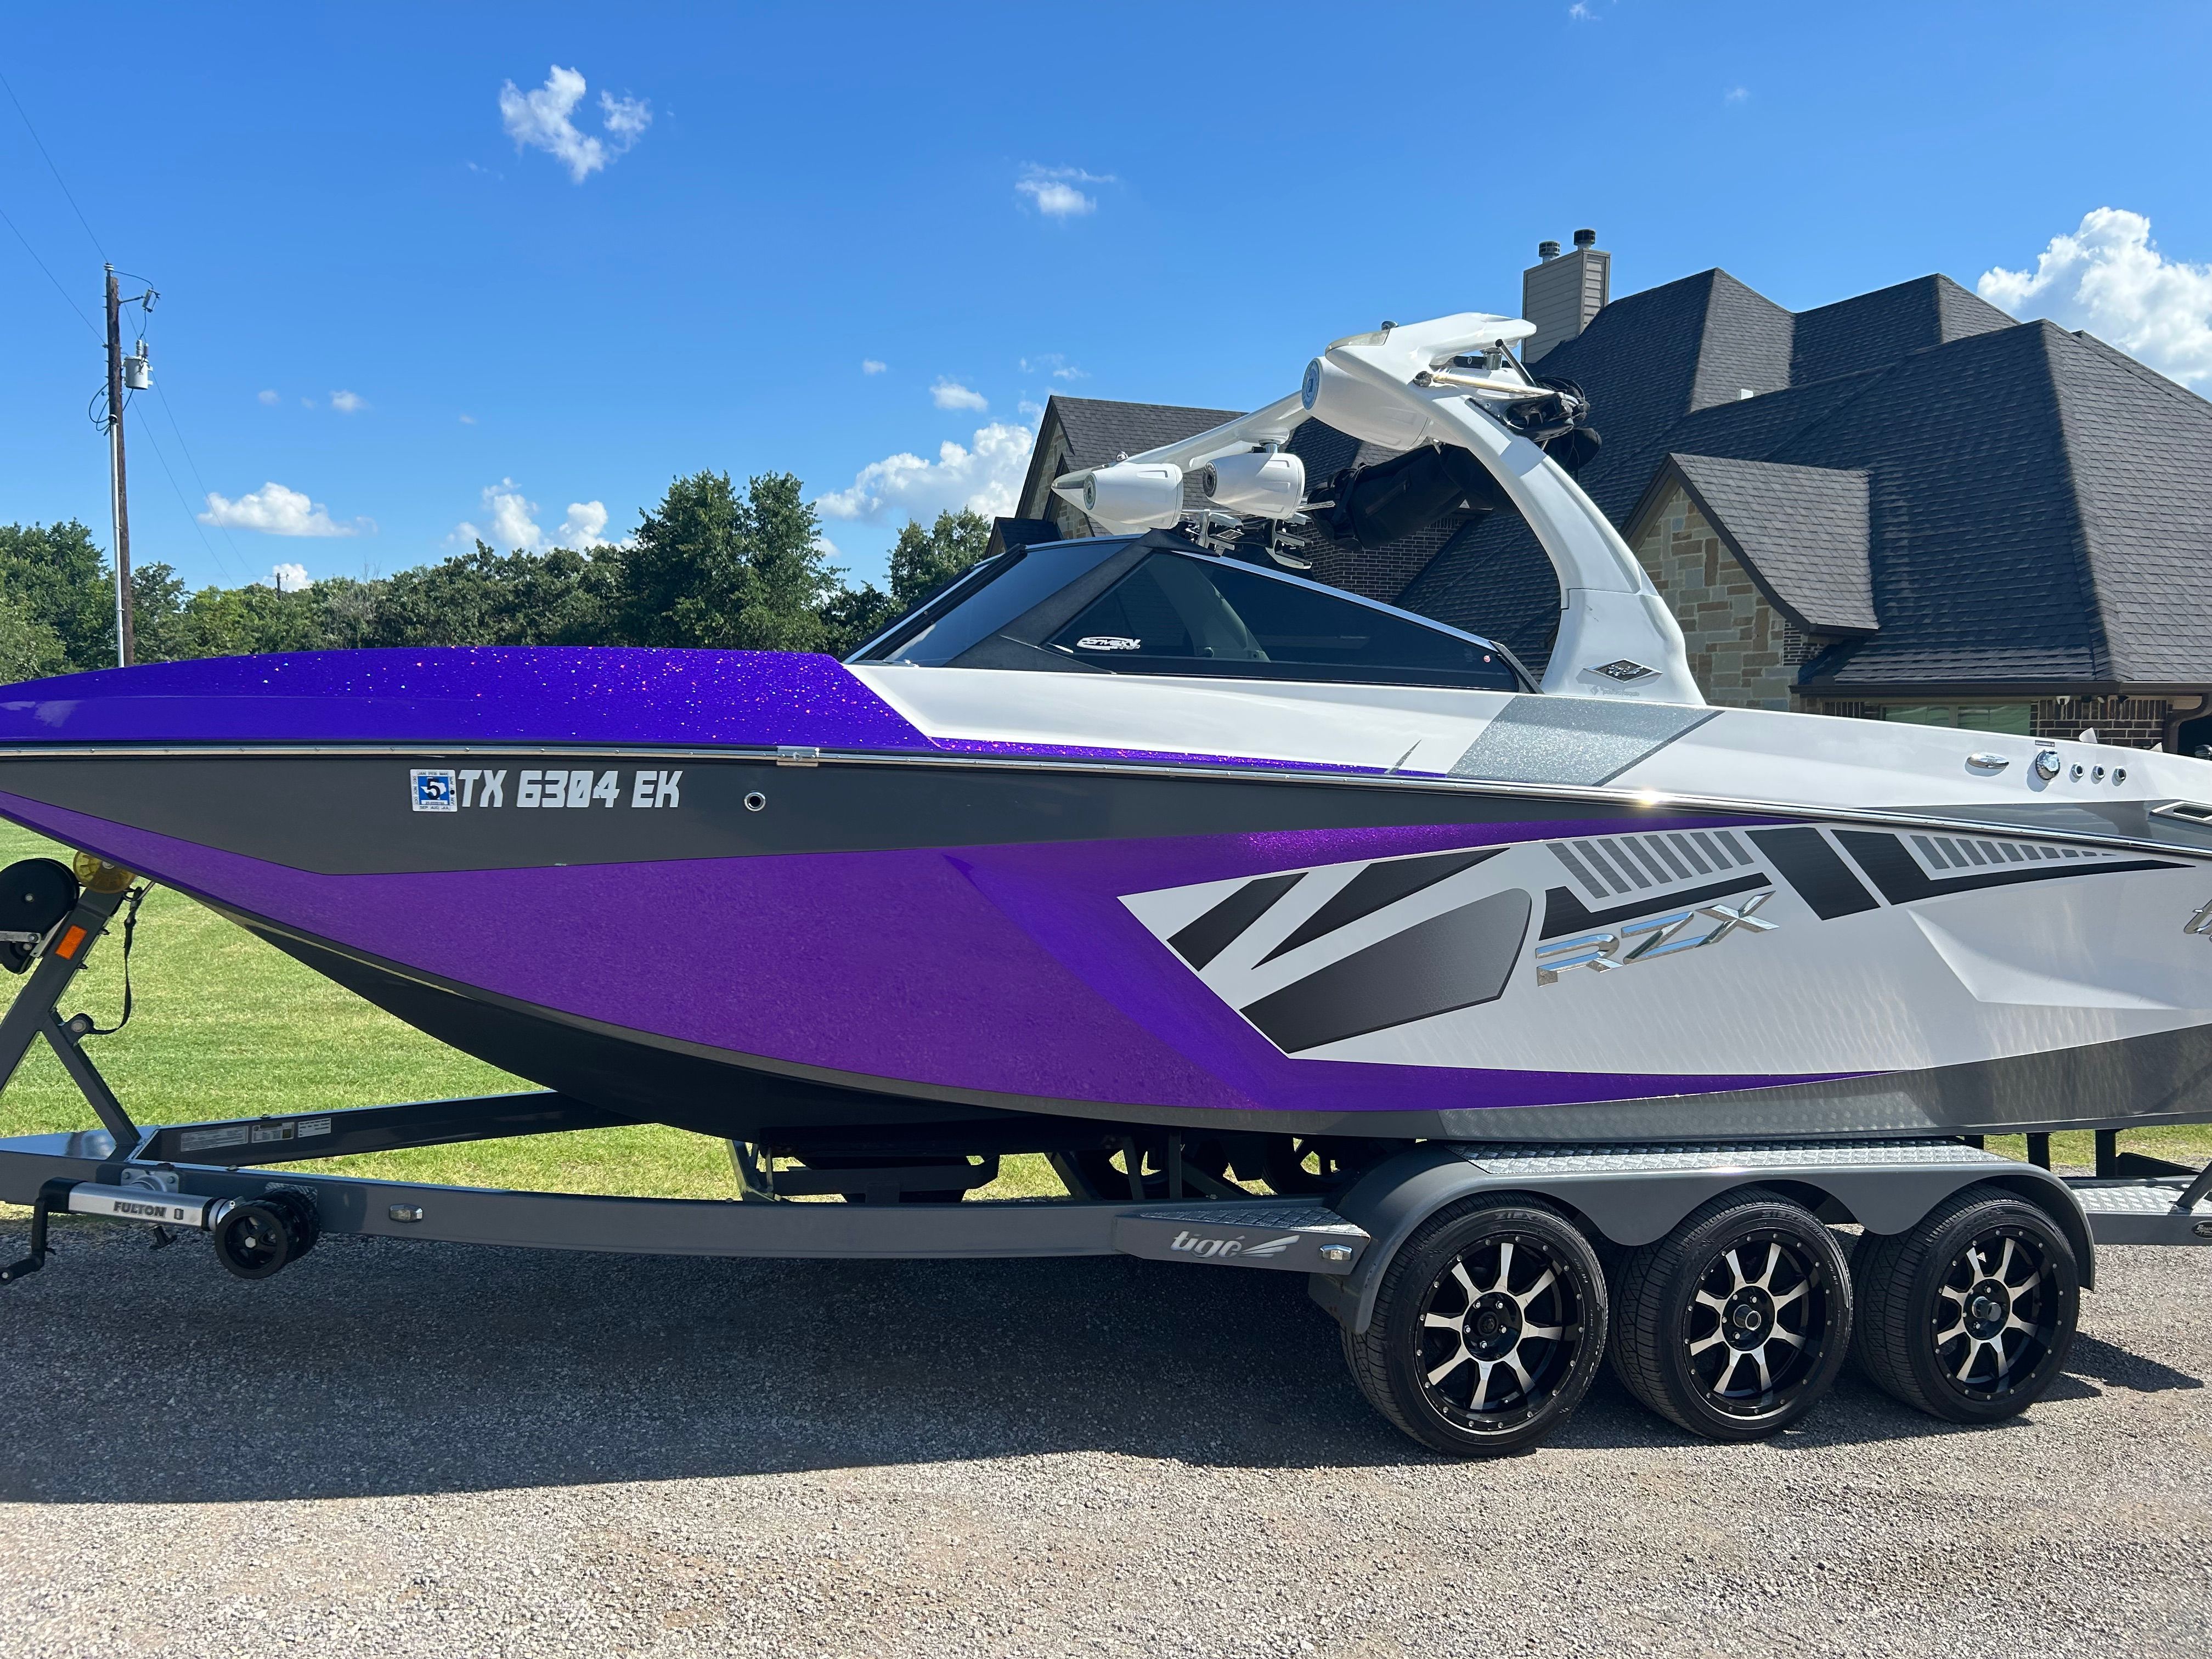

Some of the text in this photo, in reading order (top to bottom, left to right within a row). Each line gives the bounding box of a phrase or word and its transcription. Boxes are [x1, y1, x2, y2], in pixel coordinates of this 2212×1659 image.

[427, 778, 441, 800] 5
[458, 770, 683, 808] TX 6304 EK
[1535, 890, 1780, 987] RZX
[113, 1200, 167, 1218] FULTON
[1170, 1231, 1246, 1258] tigé
